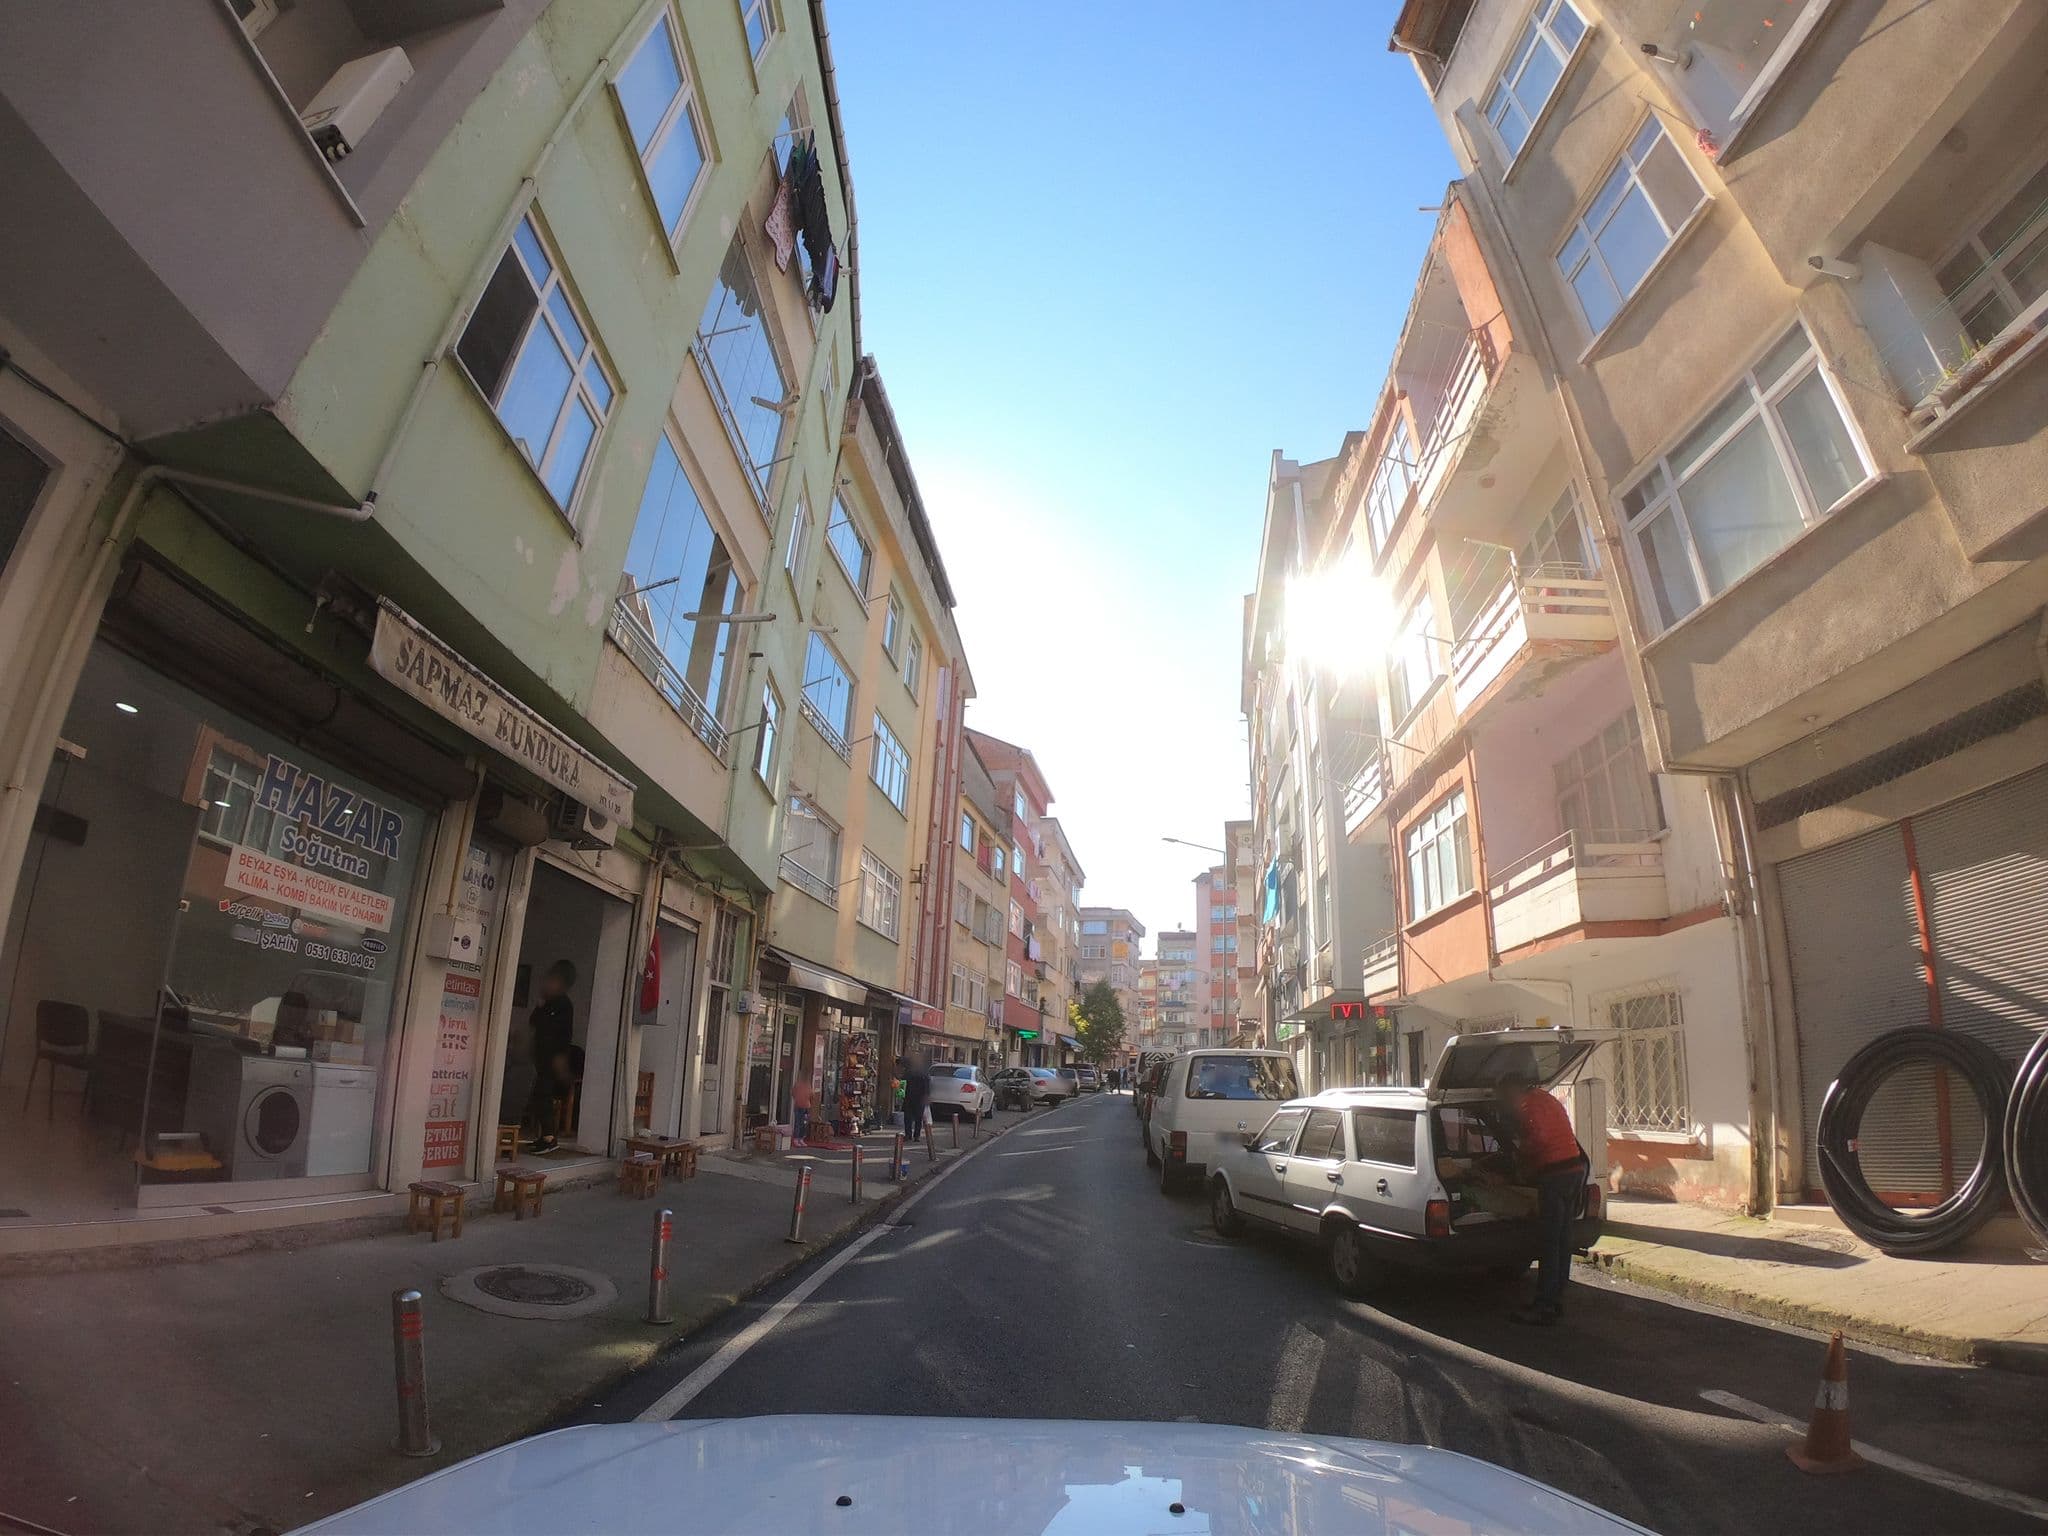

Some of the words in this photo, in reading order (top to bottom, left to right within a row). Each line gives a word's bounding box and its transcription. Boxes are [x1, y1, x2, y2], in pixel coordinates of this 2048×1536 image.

[395, 637, 489, 726] SAPMAZ
[494, 706, 580, 789] KUNDURA
[255, 753, 403, 861] HAZAR
[239, 853, 271, 874] BEYAZ
[274, 865, 297, 883] EŞYA
[305, 875, 337, 896] KÜÇÜK
[338, 887, 350, 899] EV
[280, 825, 370, 880] Soğutma
[230, 902, 264, 922] arçelik
[263, 910, 291, 925] beko
[238, 870, 269, 891] KLİMA
[277, 884, 308, 903] KOMBİ
[310, 894, 337, 912] BAKIM
[339, 903, 351, 915] VE
[352, 907, 384, 925] ONARIM
[261, 932, 299, 953] ŞAHİN
[305, 942, 330, 960] 0531
[331, 952, 350, 965] 633
[350, 955, 363, 967] 04
[363, 956, 376, 970] 82
[424, 1125, 463, 1143] ETKİLİ
